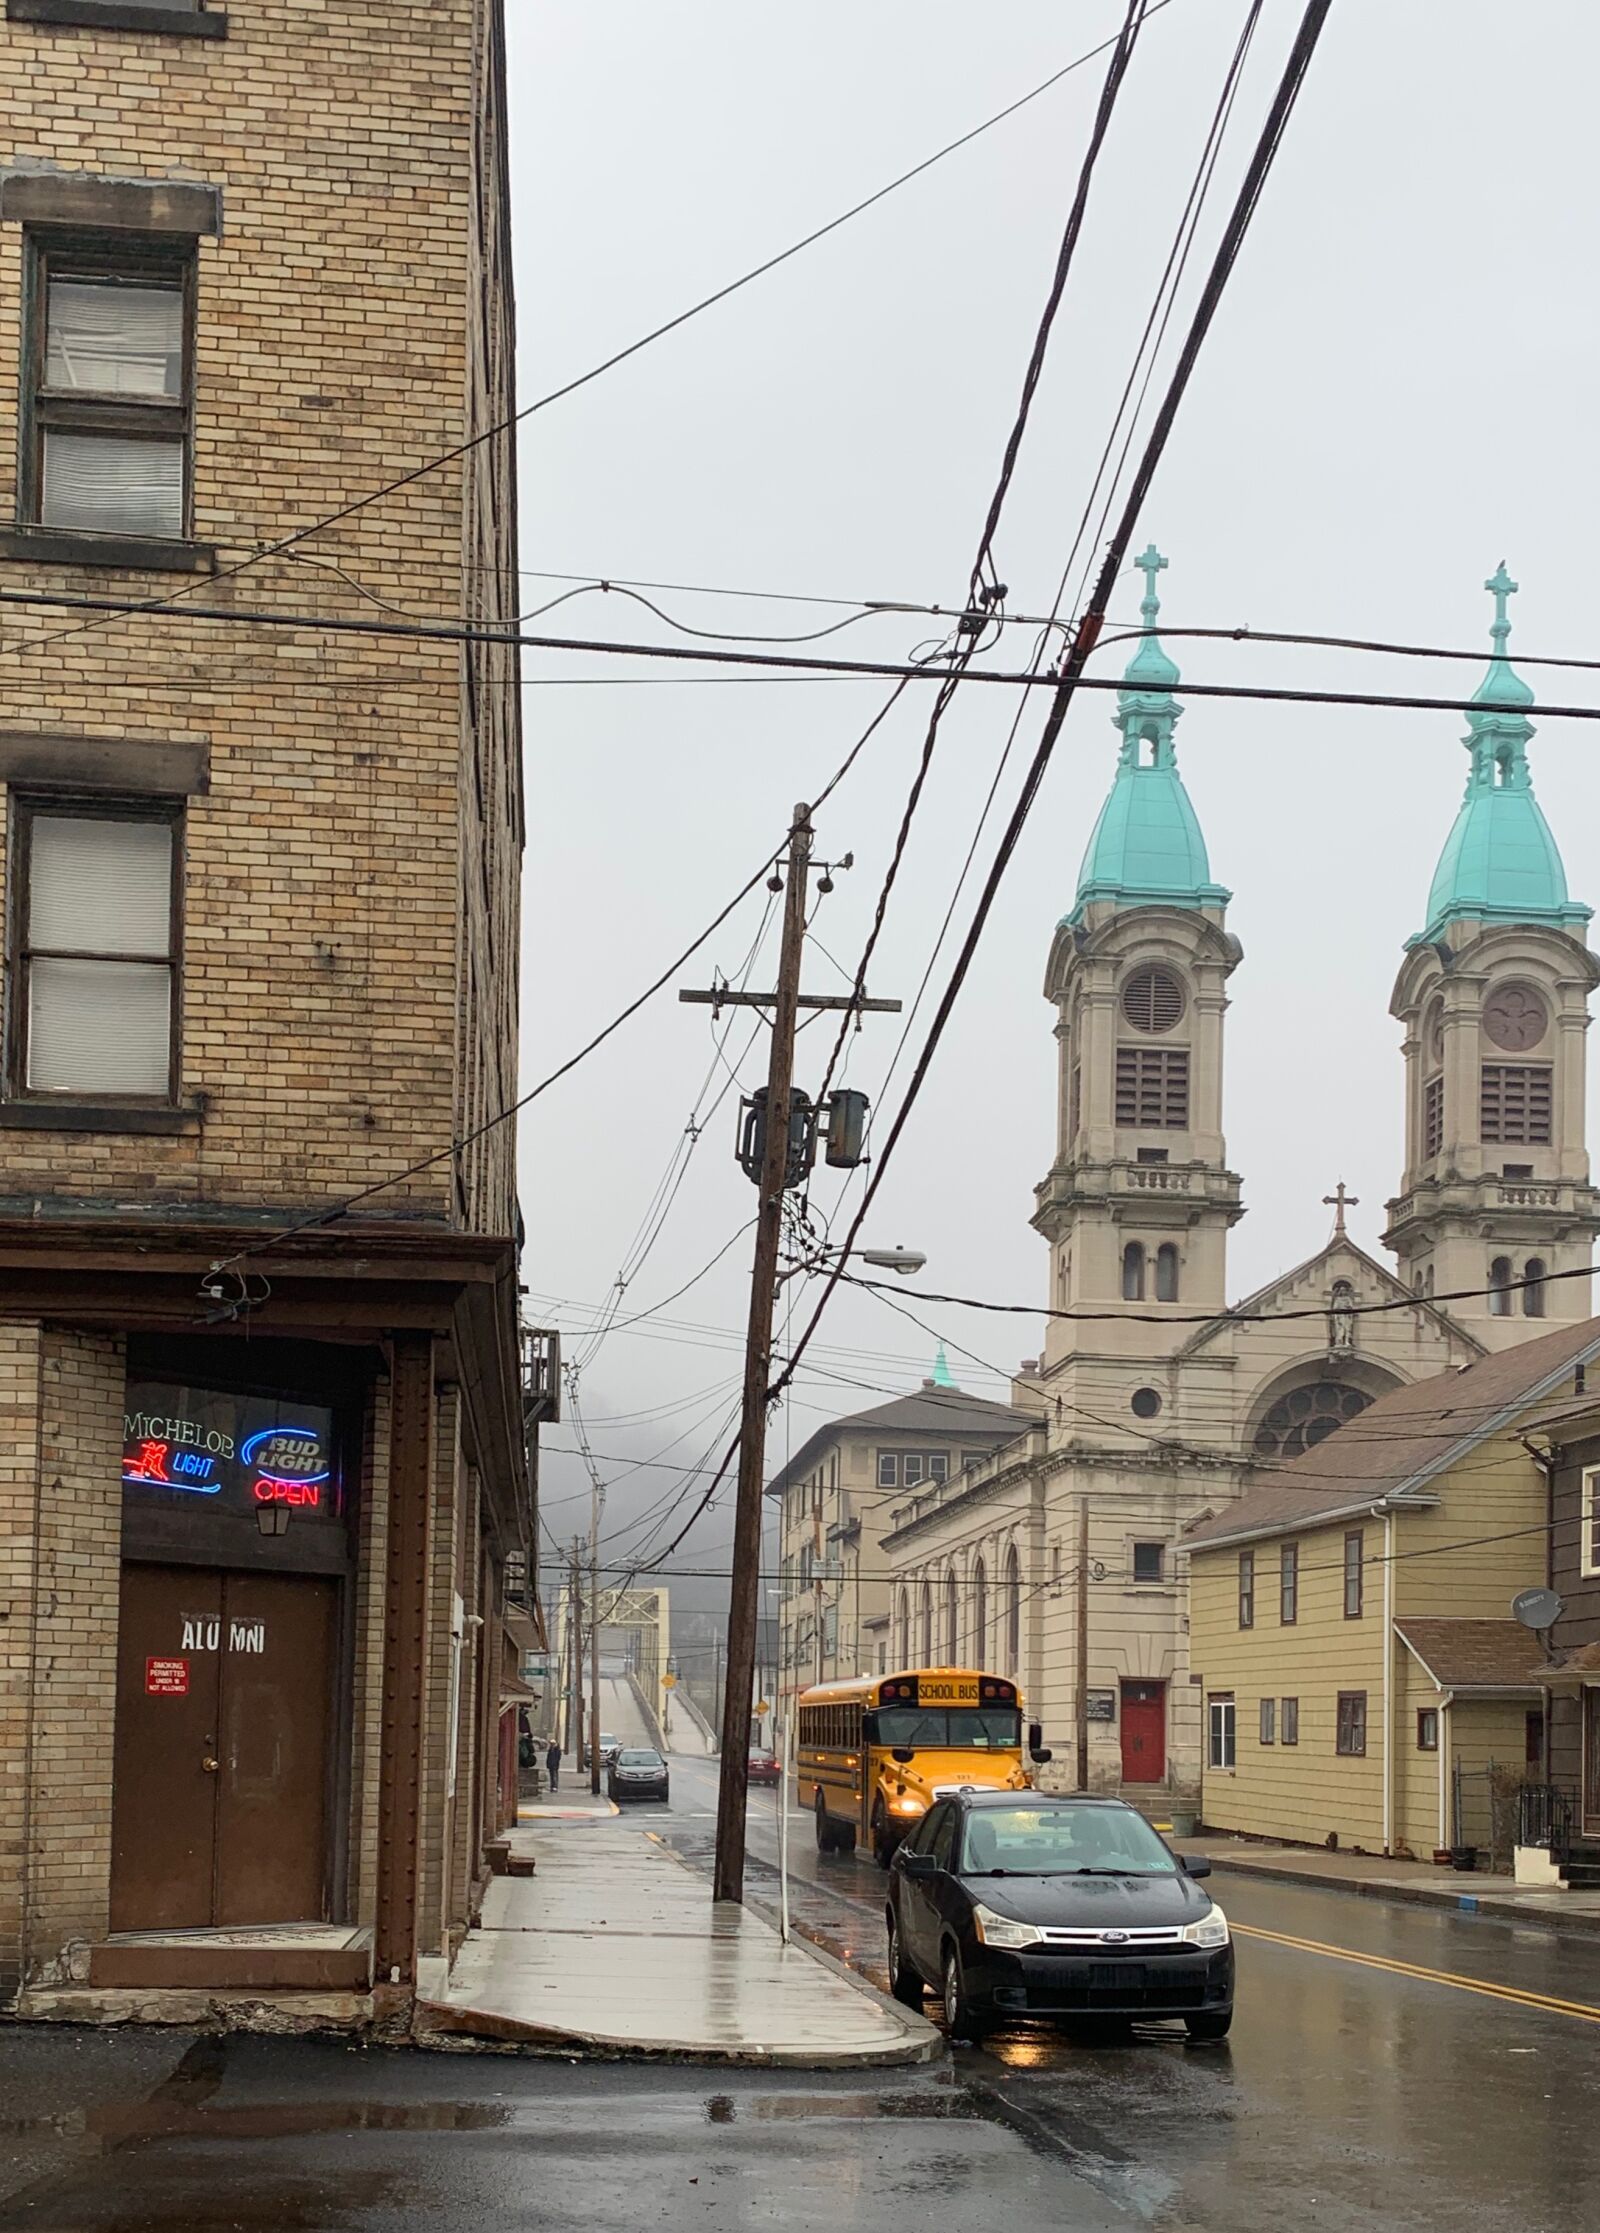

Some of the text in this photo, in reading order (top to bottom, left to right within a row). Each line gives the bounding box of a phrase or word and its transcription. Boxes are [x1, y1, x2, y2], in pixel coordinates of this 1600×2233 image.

[124, 1412, 235, 1459] MICHELOB
[269, 1437, 320, 1456] BUD
[172, 1452, 215, 1478] LIGHT
[257, 1452, 328, 1473] LIGHT
[255, 1479, 319, 1505] OPEN
[150, 1669, 186, 1677] PERMITTED
[152, 1661, 183, 1669] SMOKING
[919, 1684, 978, 1699] SCHOOL BUS
